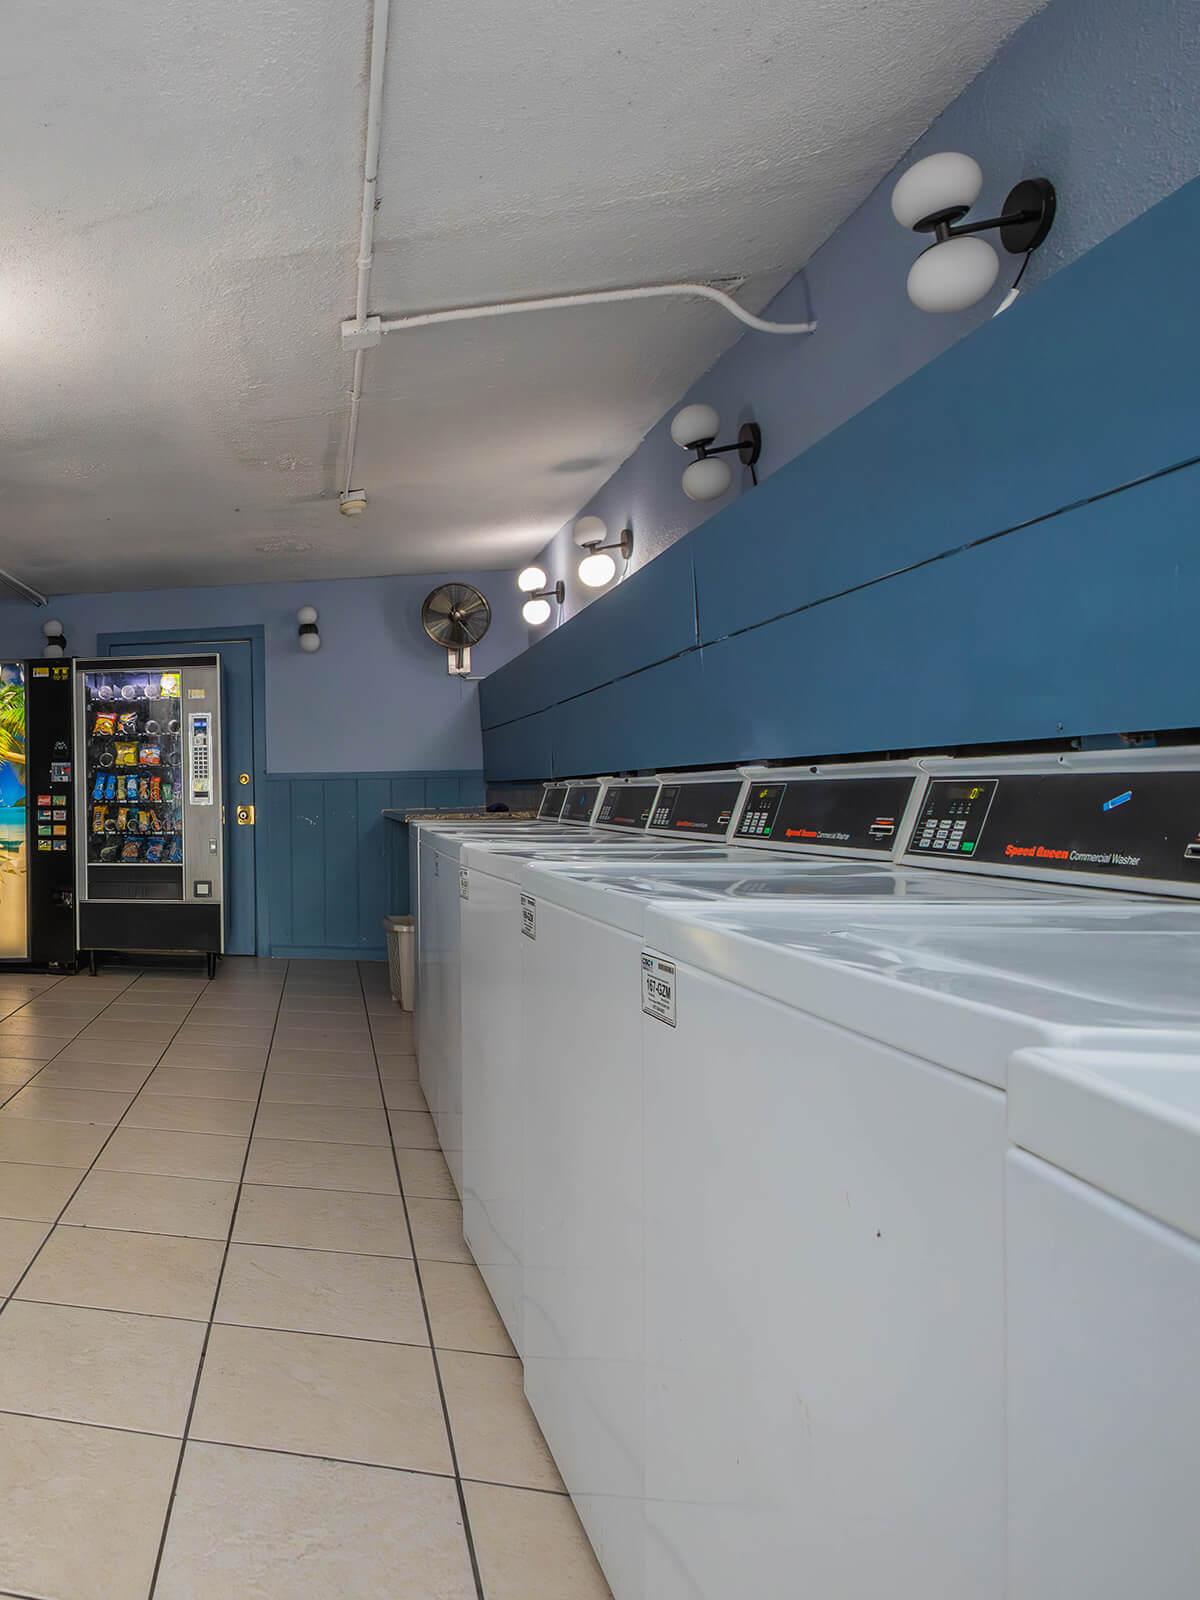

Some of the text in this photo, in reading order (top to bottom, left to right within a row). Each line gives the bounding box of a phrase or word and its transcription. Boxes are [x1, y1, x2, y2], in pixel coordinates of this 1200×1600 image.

[1005, 844, 1141, 867] Speed Queen Commercial Washer
